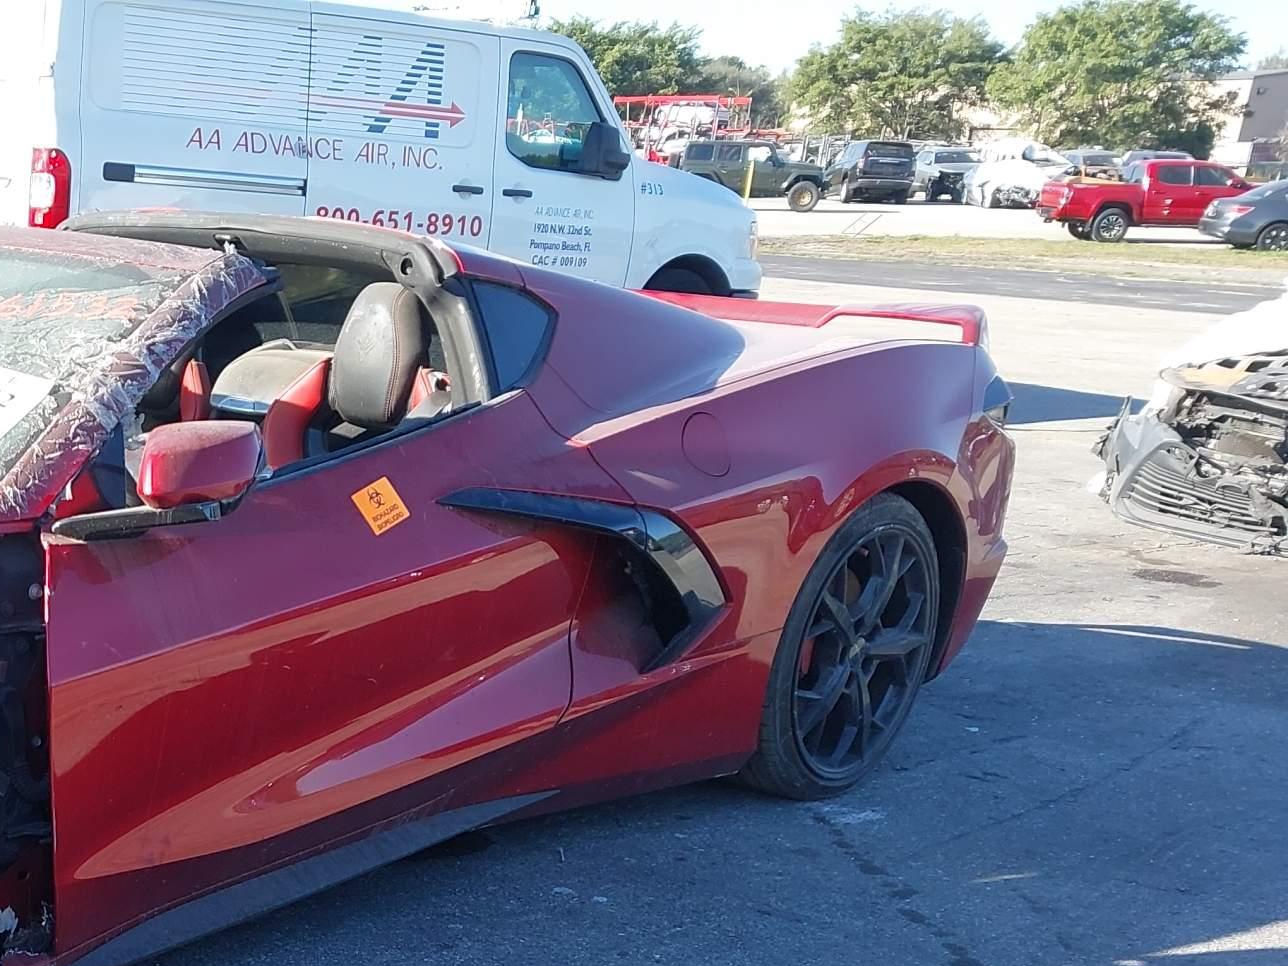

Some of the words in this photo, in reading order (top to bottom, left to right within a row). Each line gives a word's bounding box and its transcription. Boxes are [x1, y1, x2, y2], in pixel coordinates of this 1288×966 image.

[185, 127, 222, 151] AA
[232, 131, 344, 161] ADVANCE
[354, 141, 397, 169] AIR,
[401, 147, 444, 170] INC.
[640, 182, 664, 196] #313
[534, 223, 549, 233] 1920
[550, 223, 566, 234] N.W.
[567, 224, 583, 235] 32nd
[529, 239, 560, 252] Pompano
[531, 254, 550, 266] CAC
[551, 255, 558, 266] #
